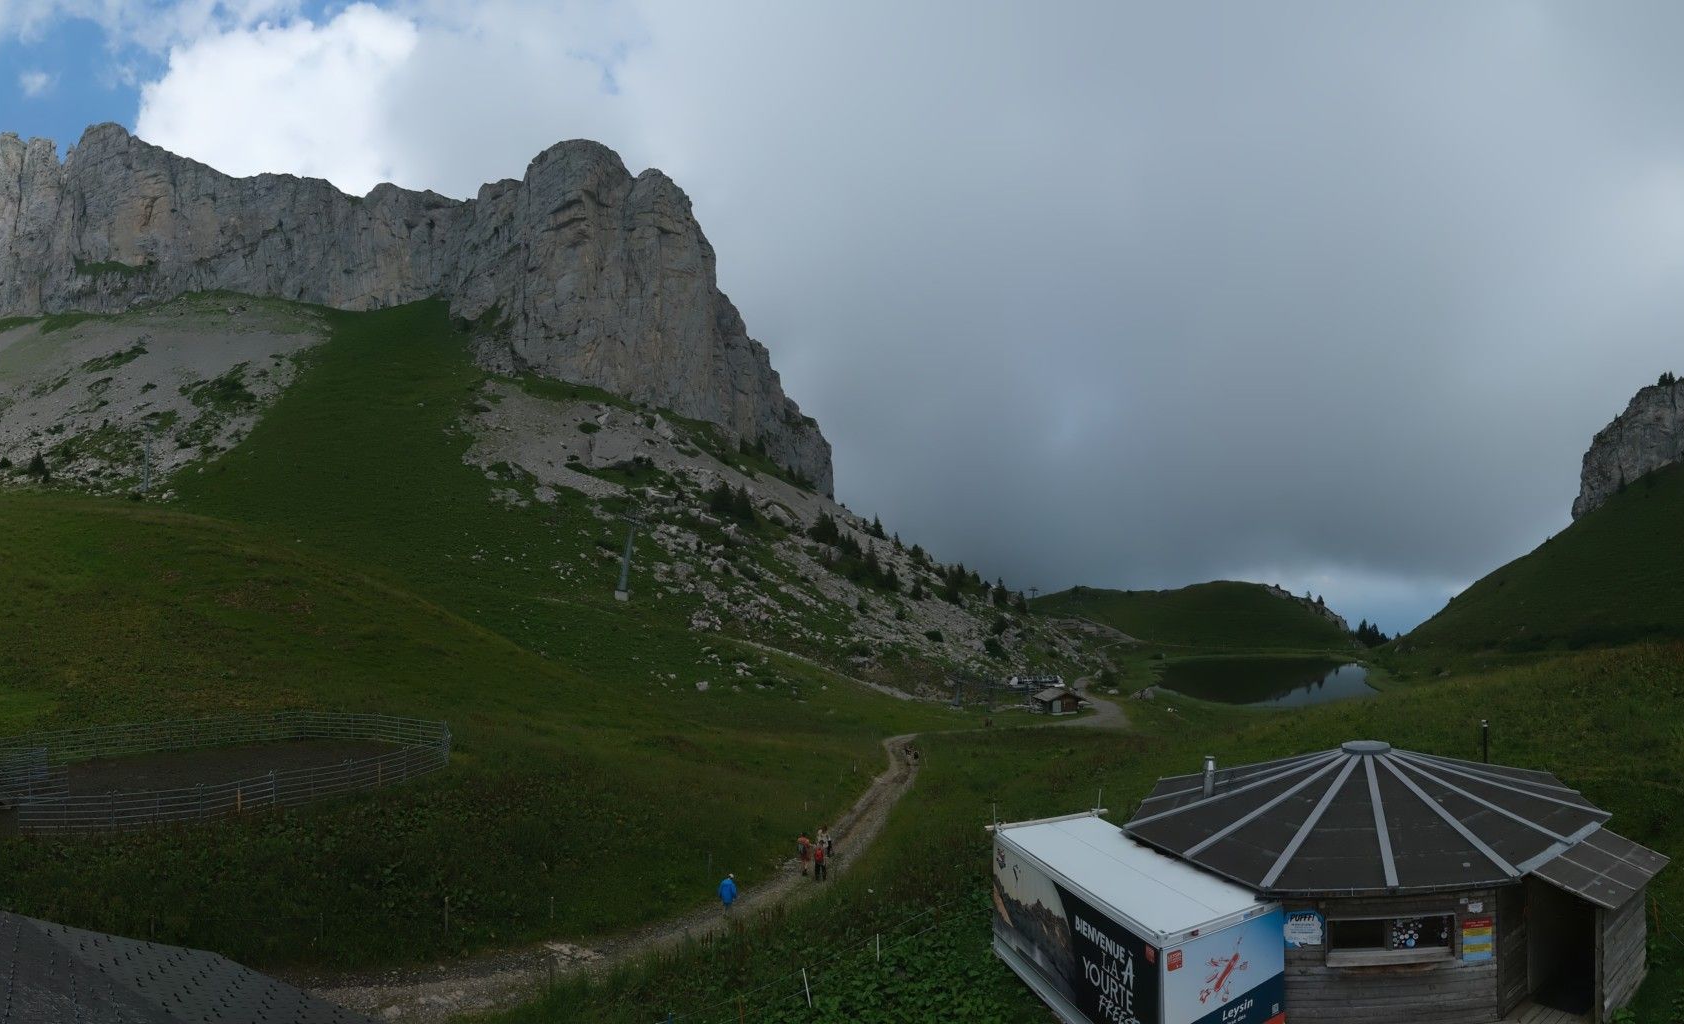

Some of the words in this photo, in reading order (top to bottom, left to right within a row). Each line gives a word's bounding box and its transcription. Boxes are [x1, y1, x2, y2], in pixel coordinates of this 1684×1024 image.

[1075, 915, 1126, 965] BIENVENUE
[1121, 950, 1135, 990] À
[1101, 951, 1120, 981] LA
[1082, 955, 1134, 1016] YOURTE
[1222, 998, 1253, 1022] Leysin
